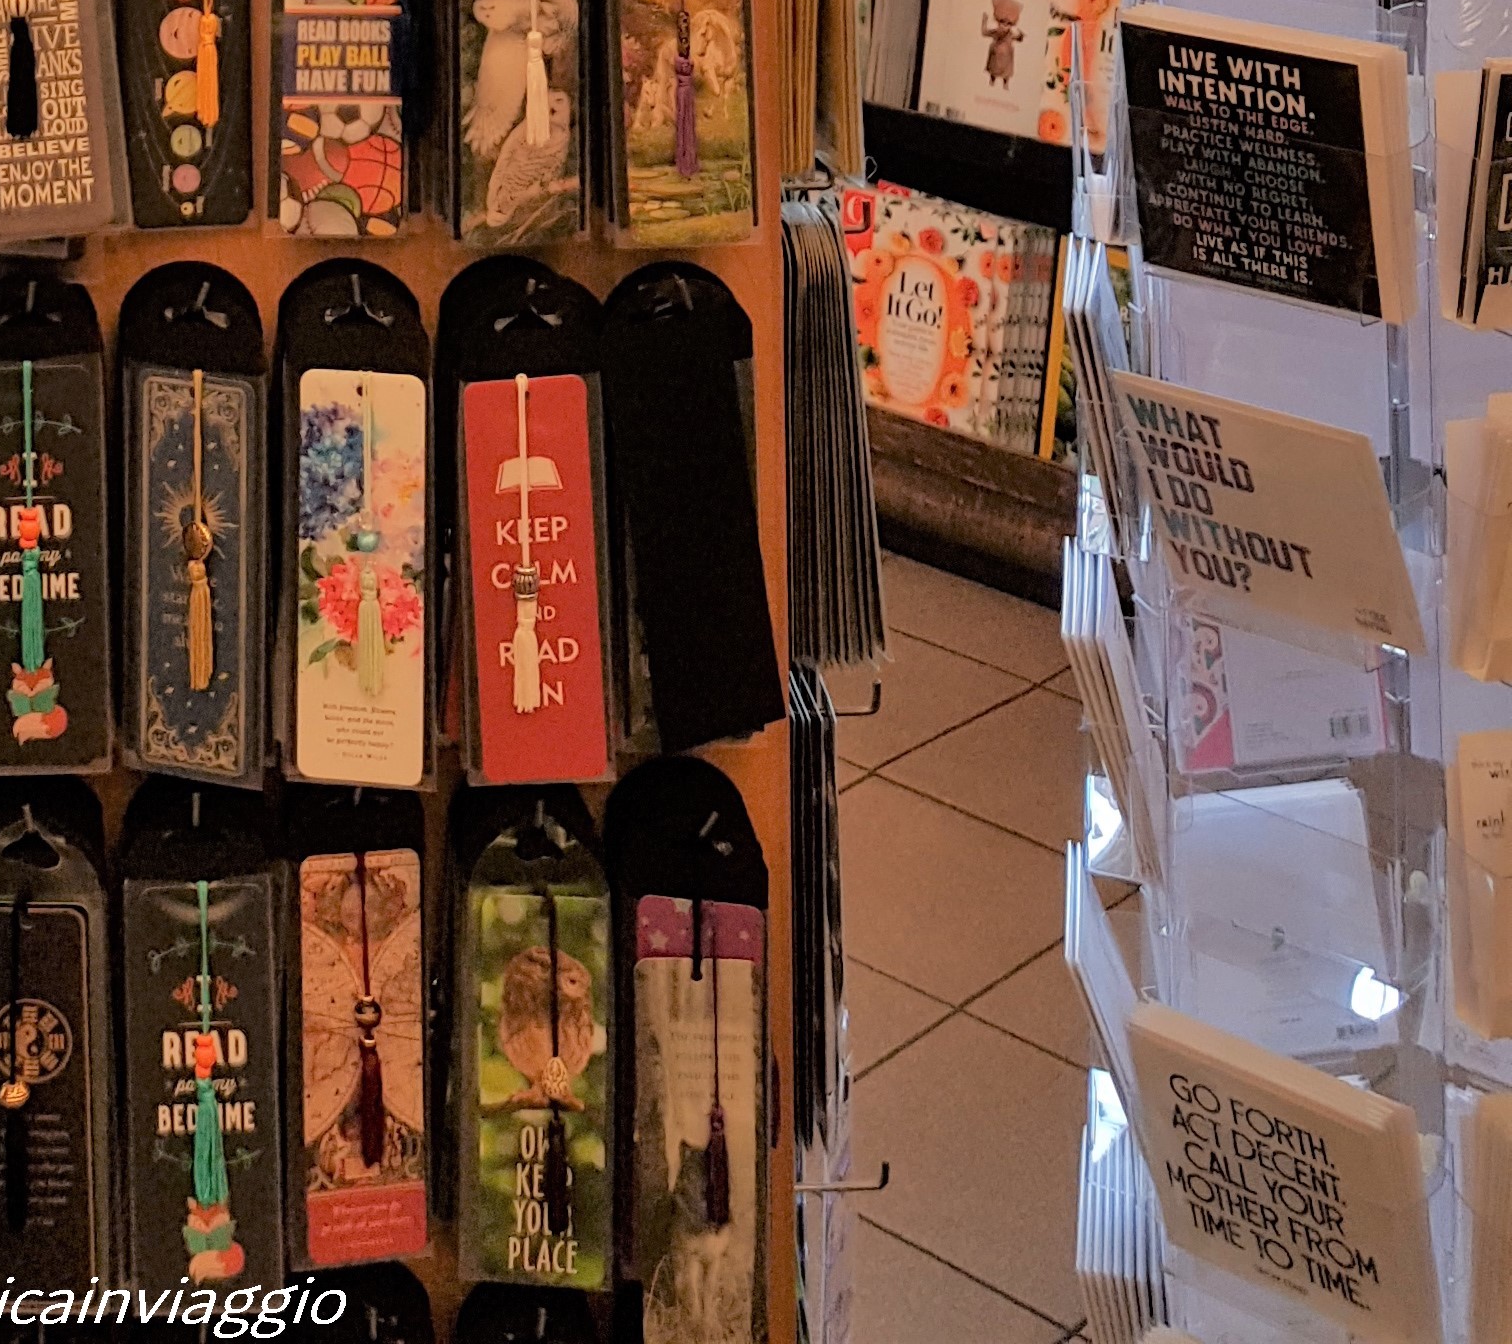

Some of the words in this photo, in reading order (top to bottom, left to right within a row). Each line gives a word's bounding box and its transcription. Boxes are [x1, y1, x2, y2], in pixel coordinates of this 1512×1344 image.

[297, 19, 335, 43] READ
[338, 19, 391, 43] BOOKS
[296, 44, 342, 67] PLAY
[346, 44, 390, 67] BALL
[1168, 45, 1219, 75] LIVE
[1226, 54, 1301, 90] WITH
[40, 79, 85, 99] SING
[296, 69, 347, 92] HAVE
[352, 69, 390, 92] FUN
[1158, 69, 1315, 120] INTENTION.
[41, 97, 86, 119] OUT
[43, 118, 88, 138] LOUD
[1164, 94, 1203, 113] WALK
[1209, 102, 1230, 118] TO
[1236, 109, 1264, 125] THE
[1272, 115, 1315, 135] EDGE.
[57, 155, 92, 176] THE
[0, 177, 94, 210] MOMENT
[899, 269, 937, 301] Let
[887, 291, 907, 318] It
[905, 297, 944, 330] Go!
[1127, 393, 1222, 450] WHAT
[1136, 430, 1255, 493] WOULD
[1148, 468, 1162, 500] I
[1169, 479, 1214, 515] DO
[1160, 504, 1314, 579] WITHOUT
[1170, 541, 1252, 592] YOU?
[1169, 1074, 1221, 1114] GO
[1230, 1100, 1335, 1169] FORTH.
[1173, 1104, 1223, 1149] ACT
[1233, 1131, 1347, 1207] DECENT.
[1184, 1143, 1257, 1196] CALL
[1263, 1176, 1344, 1236] YOUR
[1166, 1161, 1281, 1238] MOTHER
[1290, 1215, 1380, 1284] FROM
[508, 1236, 578, 1274] PLACE
[1189, 1200, 1245, 1249] TIME
[1250, 1229, 1293, 1271] TO
[1302, 1257, 1371, 1312] TIME.
